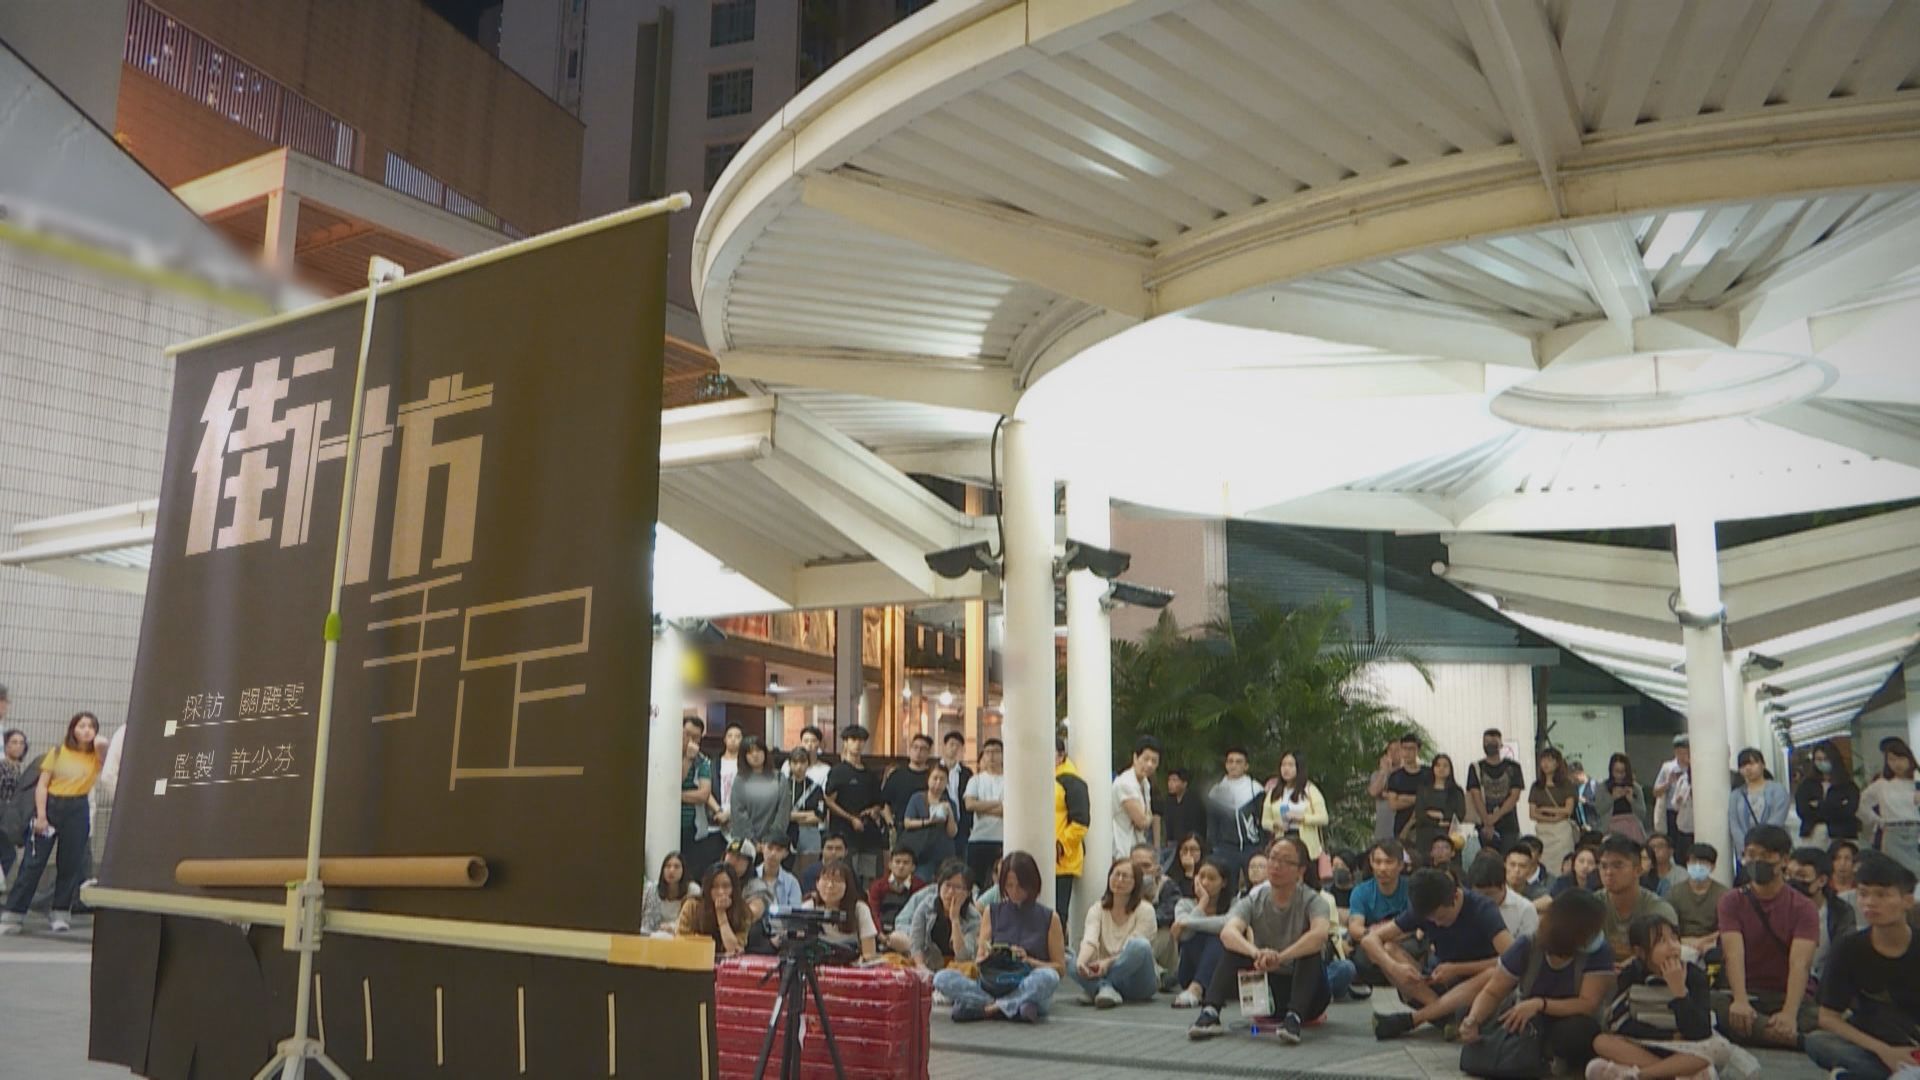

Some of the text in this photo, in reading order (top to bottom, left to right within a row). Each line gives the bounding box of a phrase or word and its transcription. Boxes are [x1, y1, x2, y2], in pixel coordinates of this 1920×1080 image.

[185, 345, 494, 586] 街坊
[182, 692, 225, 721] 採訪
[362, 572, 593, 792] 手足
[174, 743, 295, 779] 監製 許少芬
